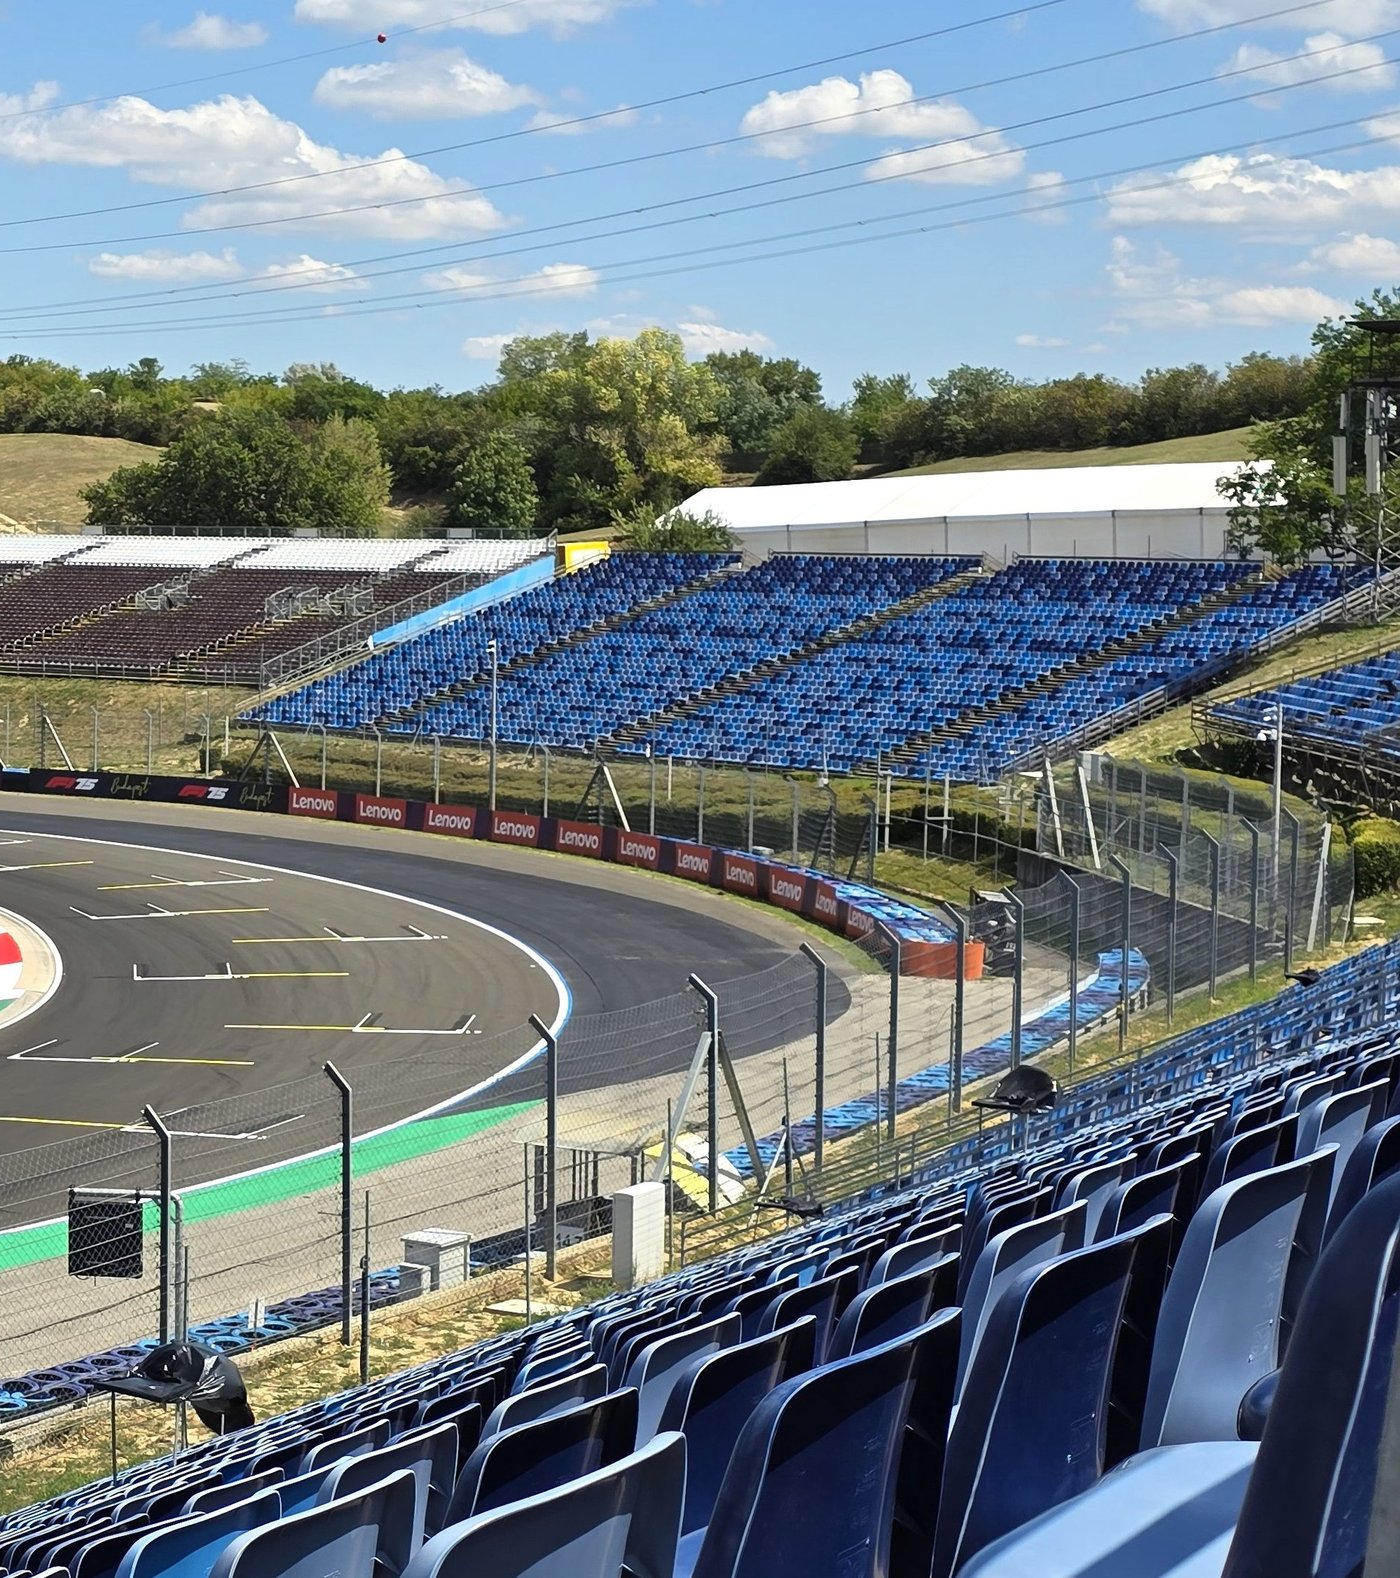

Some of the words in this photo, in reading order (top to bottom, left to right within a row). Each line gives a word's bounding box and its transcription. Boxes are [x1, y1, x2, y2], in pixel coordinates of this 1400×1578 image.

[292, 792, 335, 812] Lenovo
[360, 801, 402, 821] Lenovo
[428, 809, 471, 831] Lenovo
[494, 818, 536, 839] Lenovo
[559, 826, 599, 850] Lenovo
[620, 837, 657, 861] Lenovo
[677, 848, 709, 873] Lenovo
[726, 860, 755, 887] Lenovo
[772, 874, 802, 902] Lenovo
